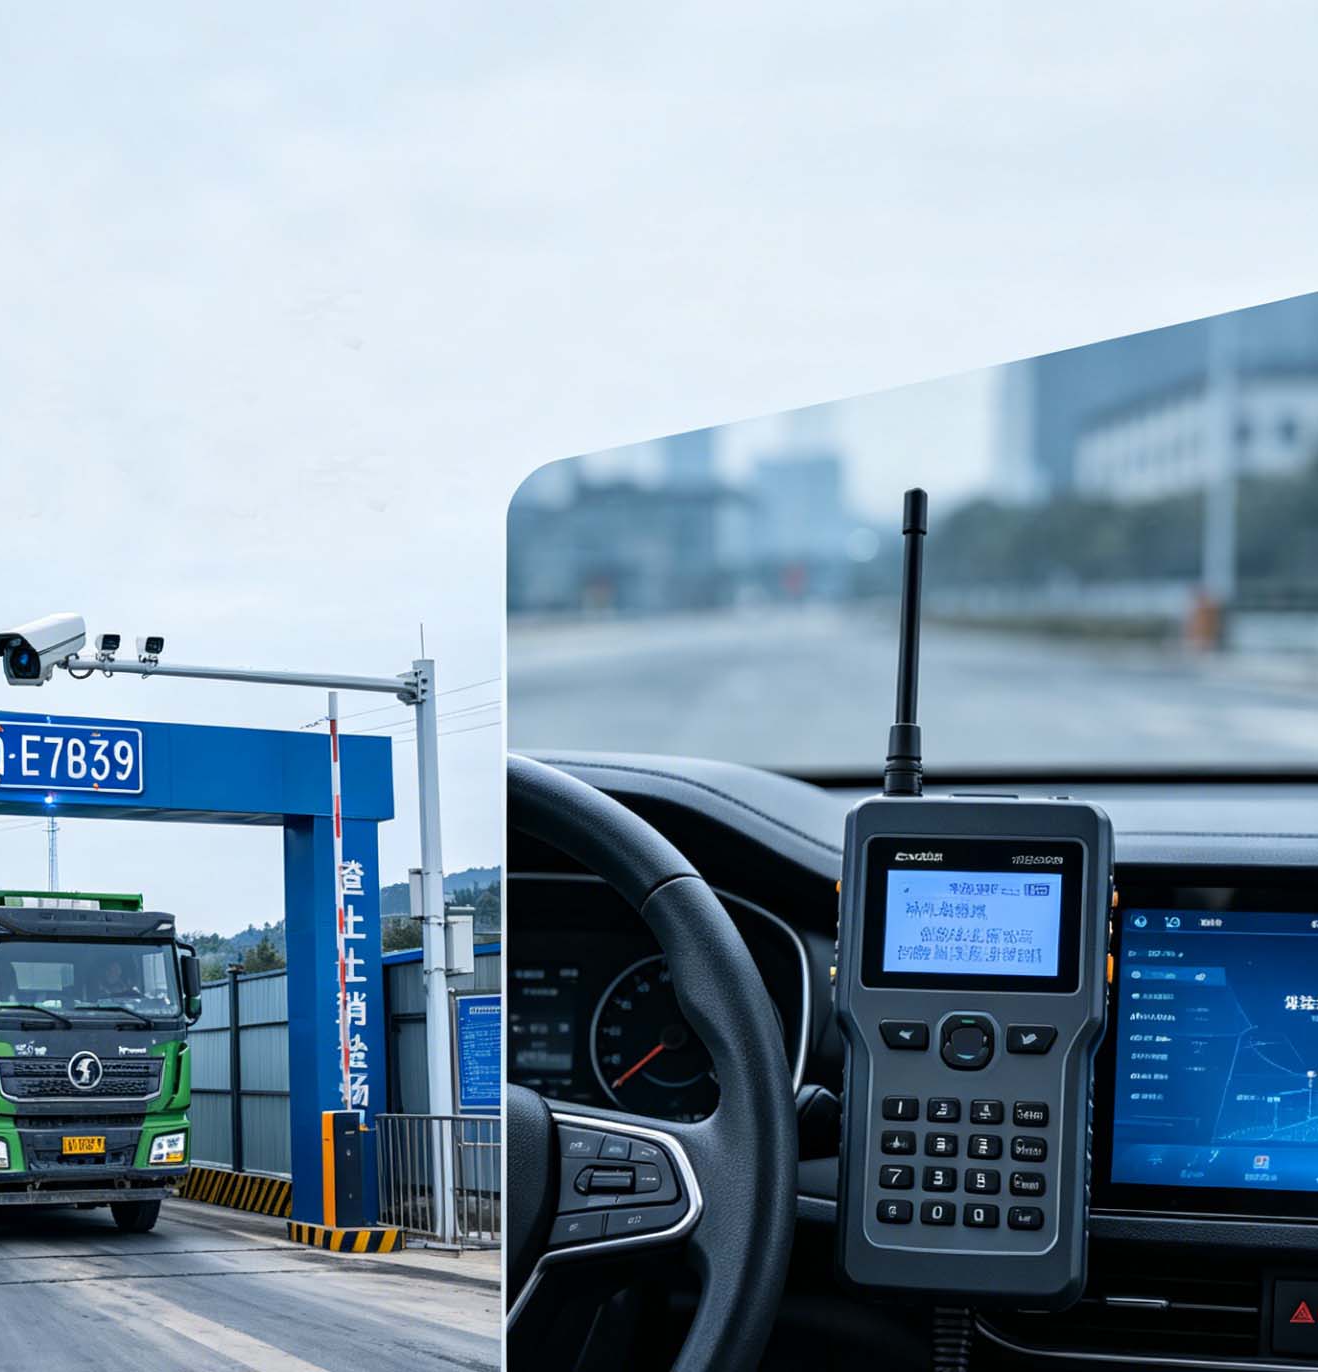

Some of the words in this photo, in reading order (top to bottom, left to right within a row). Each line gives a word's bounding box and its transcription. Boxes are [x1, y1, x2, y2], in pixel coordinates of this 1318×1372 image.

[887, 1168, 903, 1184] 7
[933, 1170, 943, 1185] 3
[932, 1205, 943, 1220] 0
